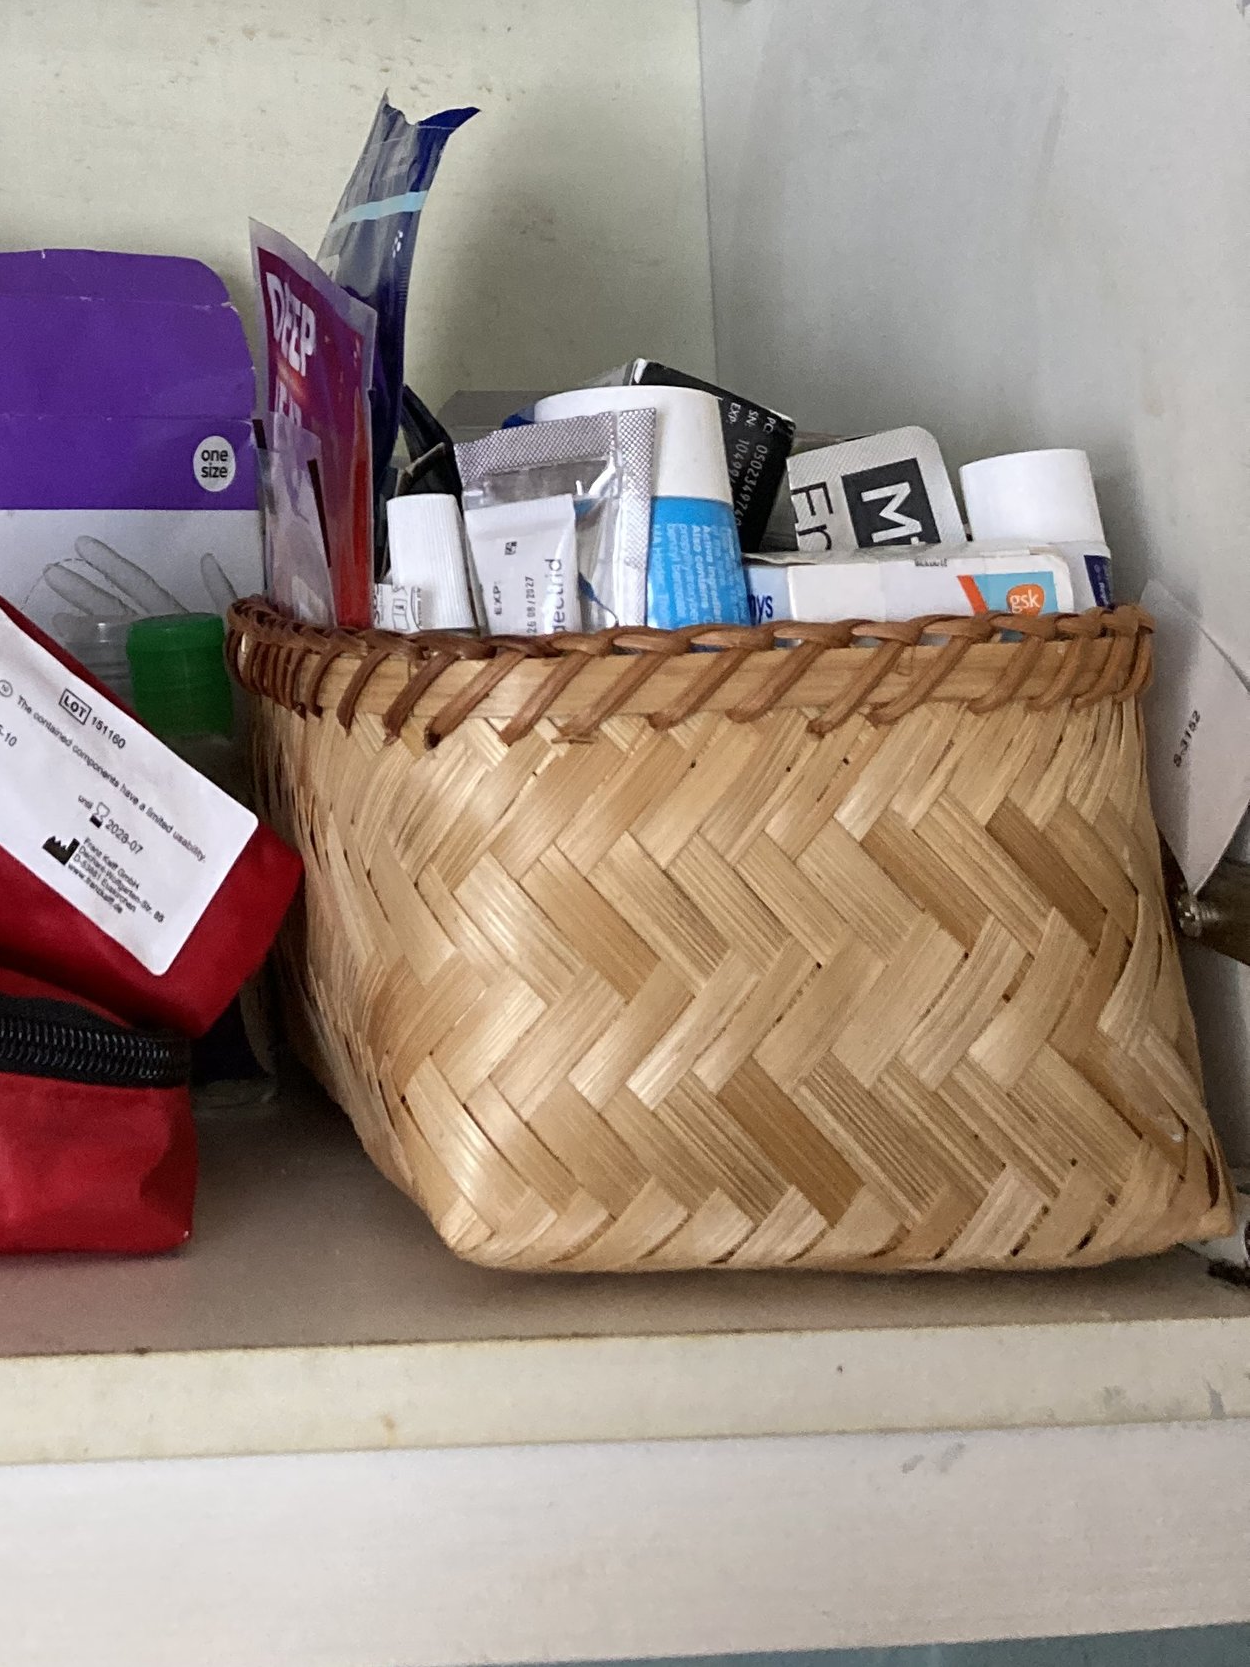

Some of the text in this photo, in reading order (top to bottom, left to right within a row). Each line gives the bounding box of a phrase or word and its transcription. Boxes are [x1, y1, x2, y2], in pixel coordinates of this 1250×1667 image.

[266, 272, 316, 377] DEEP
[201, 449, 228, 462] one
[201, 462, 228, 478] size
[860, 481, 924, 545] M
[1010, 589, 1041, 614] gsk
[62, 695, 128, 750] LOT 151160
[15, 695, 35, 714] The
[32, 709, 74, 747] contained
[70, 744, 121, 788] components
[118, 783, 141, 805] have
[145, 805, 176, 834] limited
[171, 829, 211, 865] usability.
[103, 818, 145, 856] 2028-07
